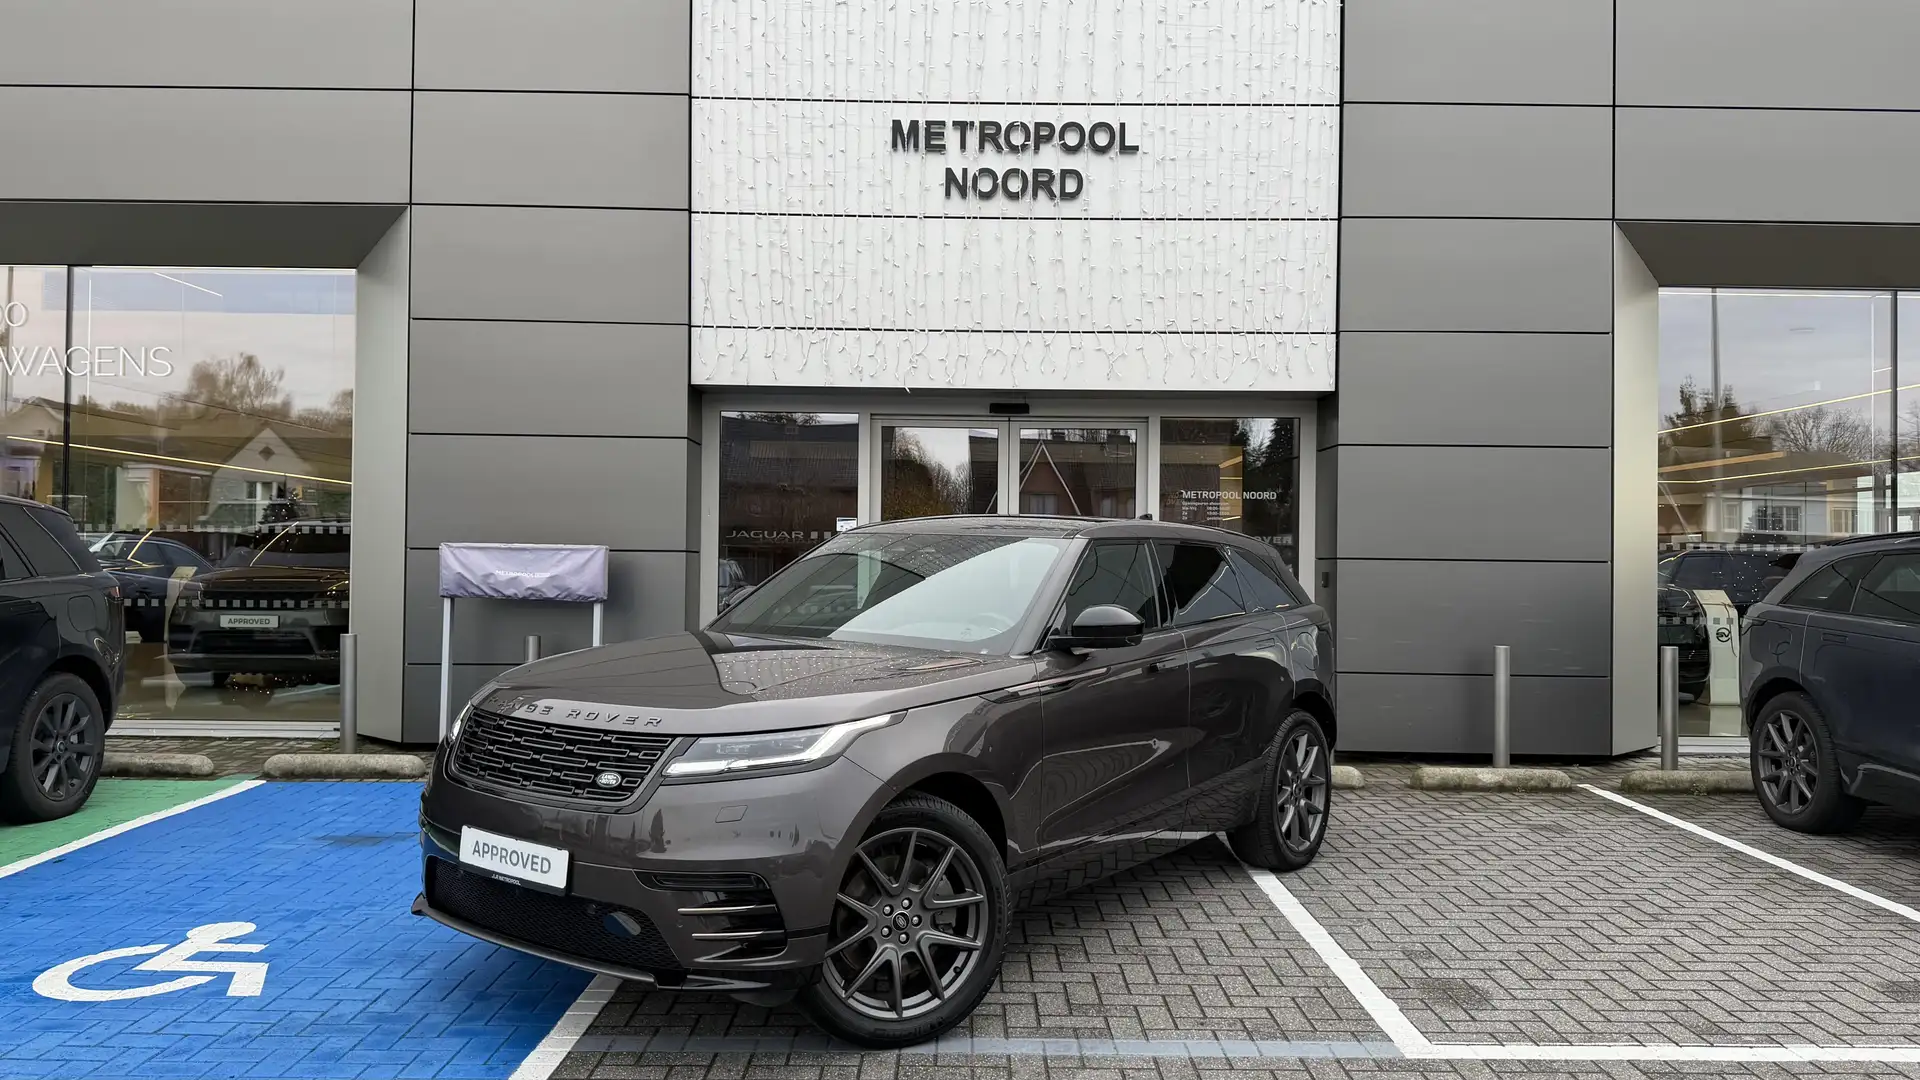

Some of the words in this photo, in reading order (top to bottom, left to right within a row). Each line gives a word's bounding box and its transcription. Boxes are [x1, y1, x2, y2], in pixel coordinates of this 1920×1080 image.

[891, 119, 1140, 153] METROPOOL
[944, 167, 1084, 200] NOORD
[1182, 490, 1241, 500] METROPOOL
[1243, 491, 1277, 500] NOORD
[725, 530, 804, 539] JAGUAR
[1254, 536, 1292, 544] OVER
[566, 708, 662, 727] ROVER
[472, 840, 551, 875] APPROVED
